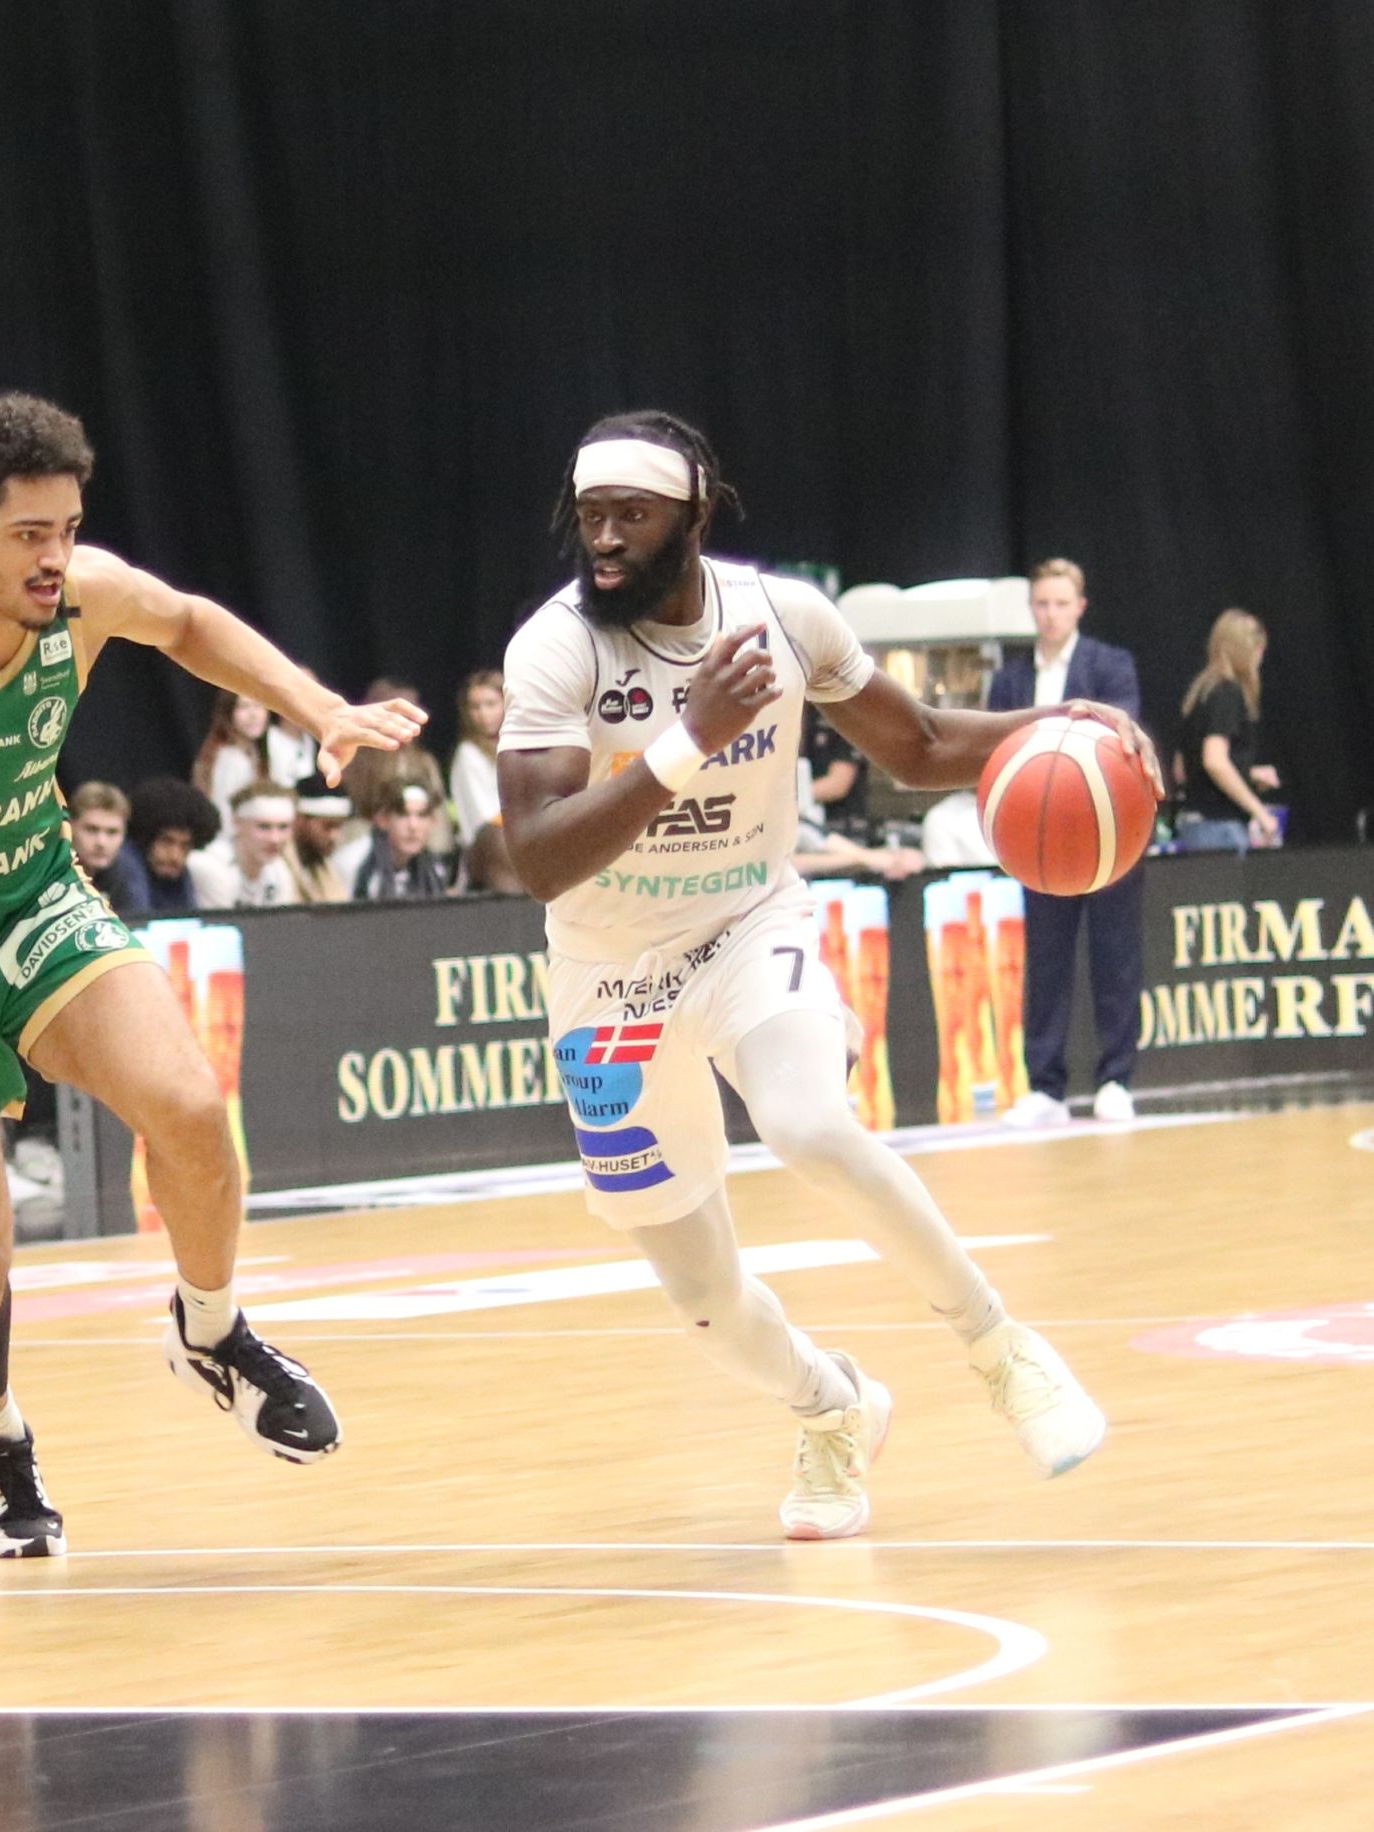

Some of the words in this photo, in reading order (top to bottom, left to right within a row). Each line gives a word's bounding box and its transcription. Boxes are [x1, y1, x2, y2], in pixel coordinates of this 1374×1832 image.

[648, 839, 729, 854] ANDERSEN
[595, 861, 768, 899] SYNTEGON
[21, 908, 88, 979] DAVIDSEN
[772, 946, 804, 992] 7
[555, 1047, 576, 1062] an
[562, 1074, 603, 1094] roup
